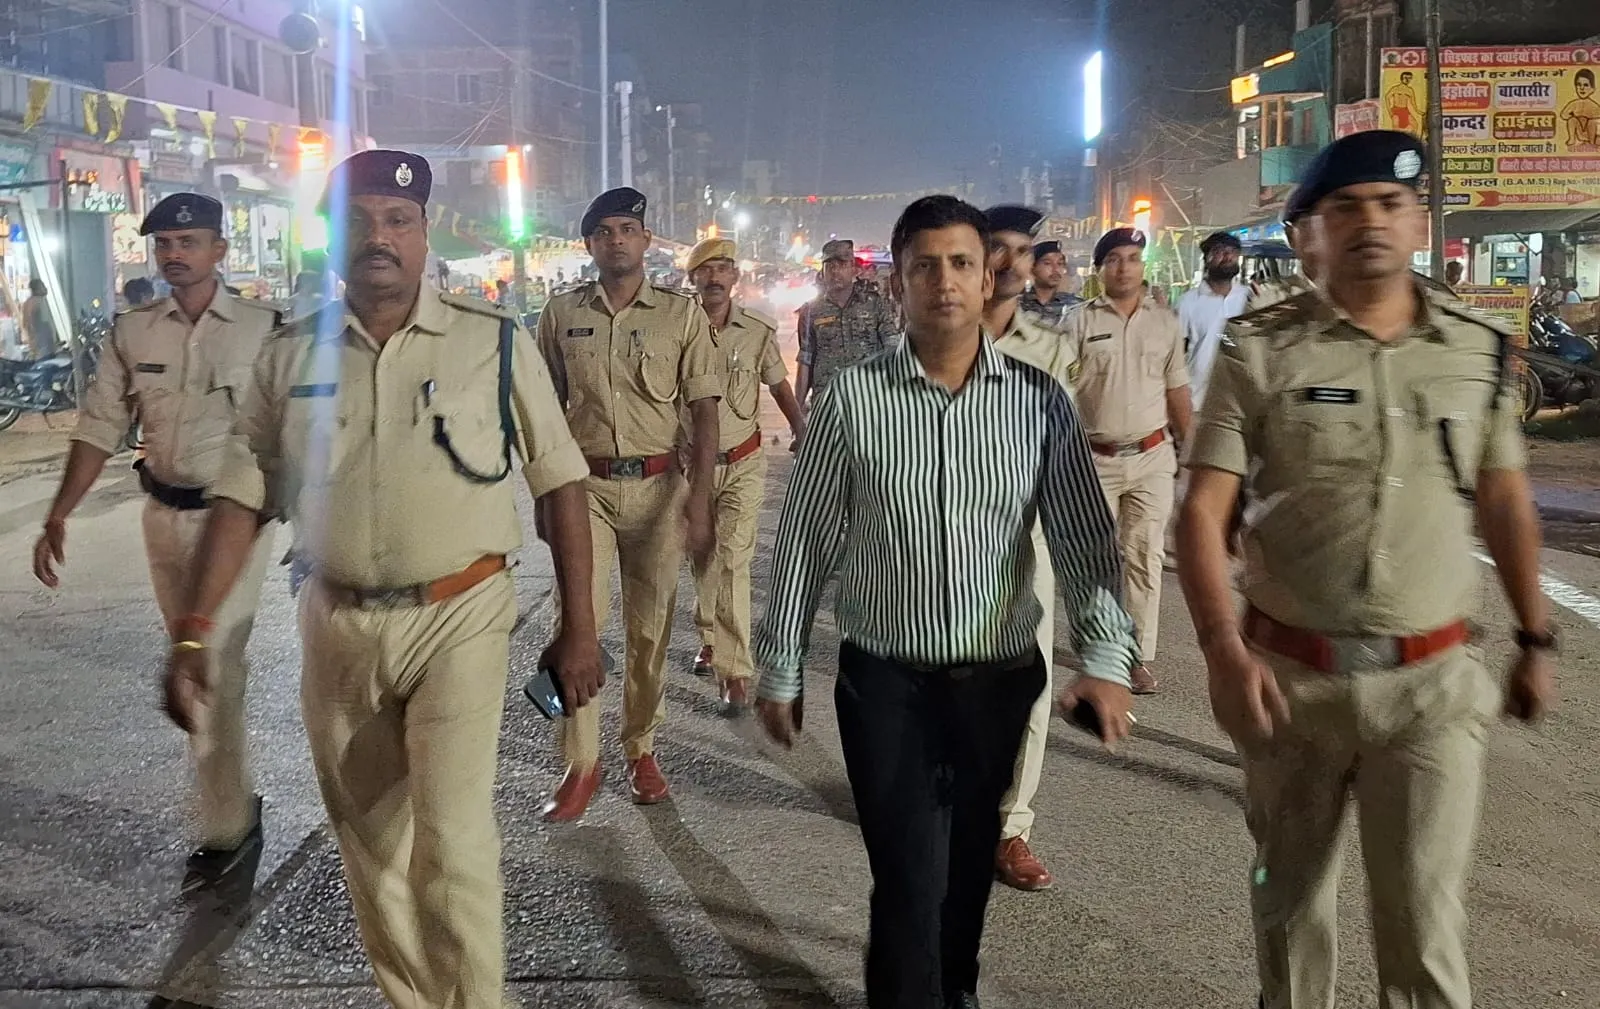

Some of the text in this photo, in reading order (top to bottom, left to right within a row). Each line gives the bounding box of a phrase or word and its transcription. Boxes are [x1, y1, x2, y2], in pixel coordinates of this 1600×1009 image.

[1498, 142, 1520, 153] किया
[1522, 143, 1544, 153] जाता
[1460, 175, 1498, 187] मंडल
[1503, 178, 1552, 188] (B.A.M.S.)
